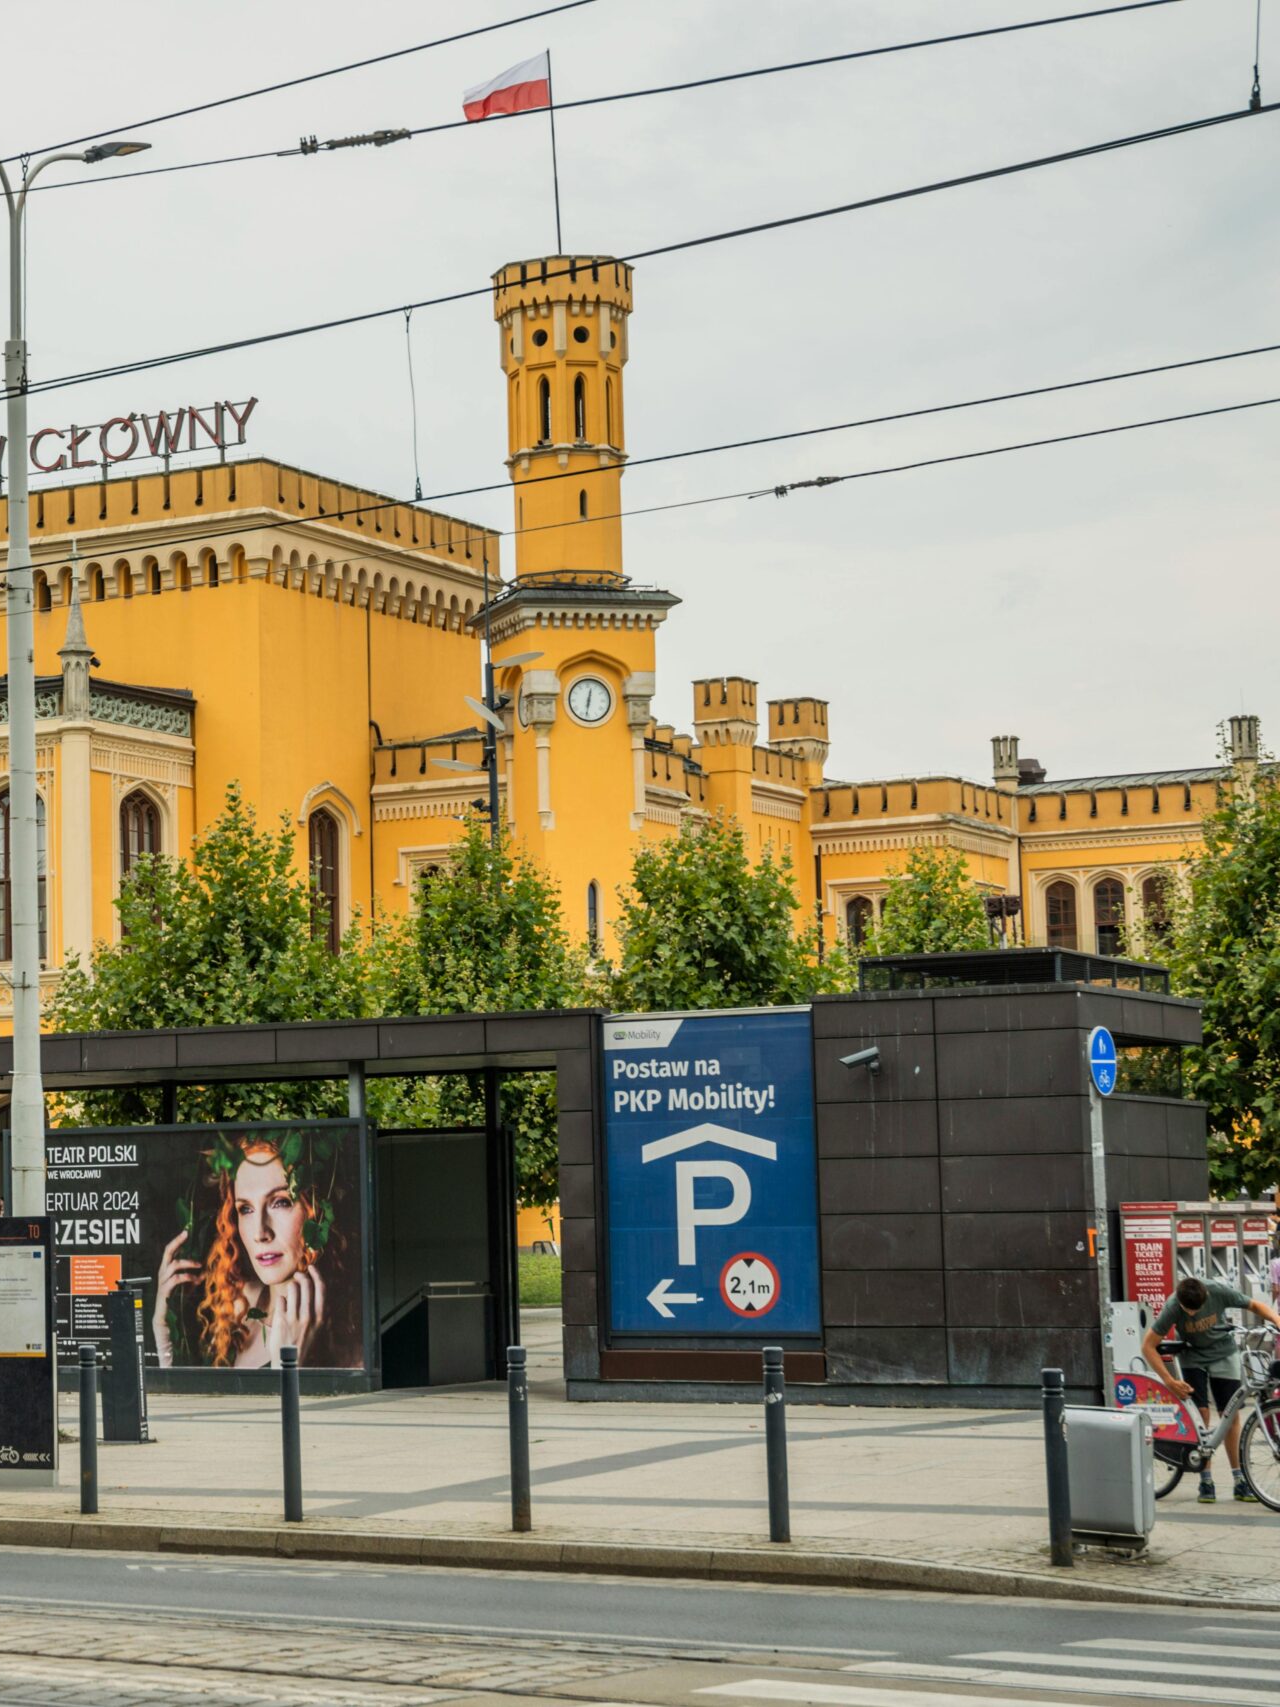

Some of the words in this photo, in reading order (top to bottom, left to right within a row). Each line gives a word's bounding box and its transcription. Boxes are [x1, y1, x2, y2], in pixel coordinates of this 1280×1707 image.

[29, 396, 259, 472] GŁÓWNY
[627, 1030, 661, 1040] Mobility
[612, 1058, 689, 1079] Postaw
[694, 1058, 721, 1076] na
[613, 1088, 662, 1113] PKP
[667, 1082, 776, 1115] Mobility!
[46, 1146, 86, 1164] TEATR
[88, 1145, 137, 1163] POLSKI
[47, 1170, 59, 1180] WE
[60, 1169, 102, 1179] WROCŁAWIU
[46, 1192, 99, 1212] ERTUAR
[103, 1191, 140, 1211] 2024
[675, 1160, 752, 1266] P
[55, 1212, 140, 1245] ZESIEŃ
[1133, 1243, 1163, 1251] TRAIN
[1135, 1263, 1164, 1271] BILETY
[730, 1276, 770, 1296] 2,1m
[1136, 1293, 1165, 1302] TRAIN
